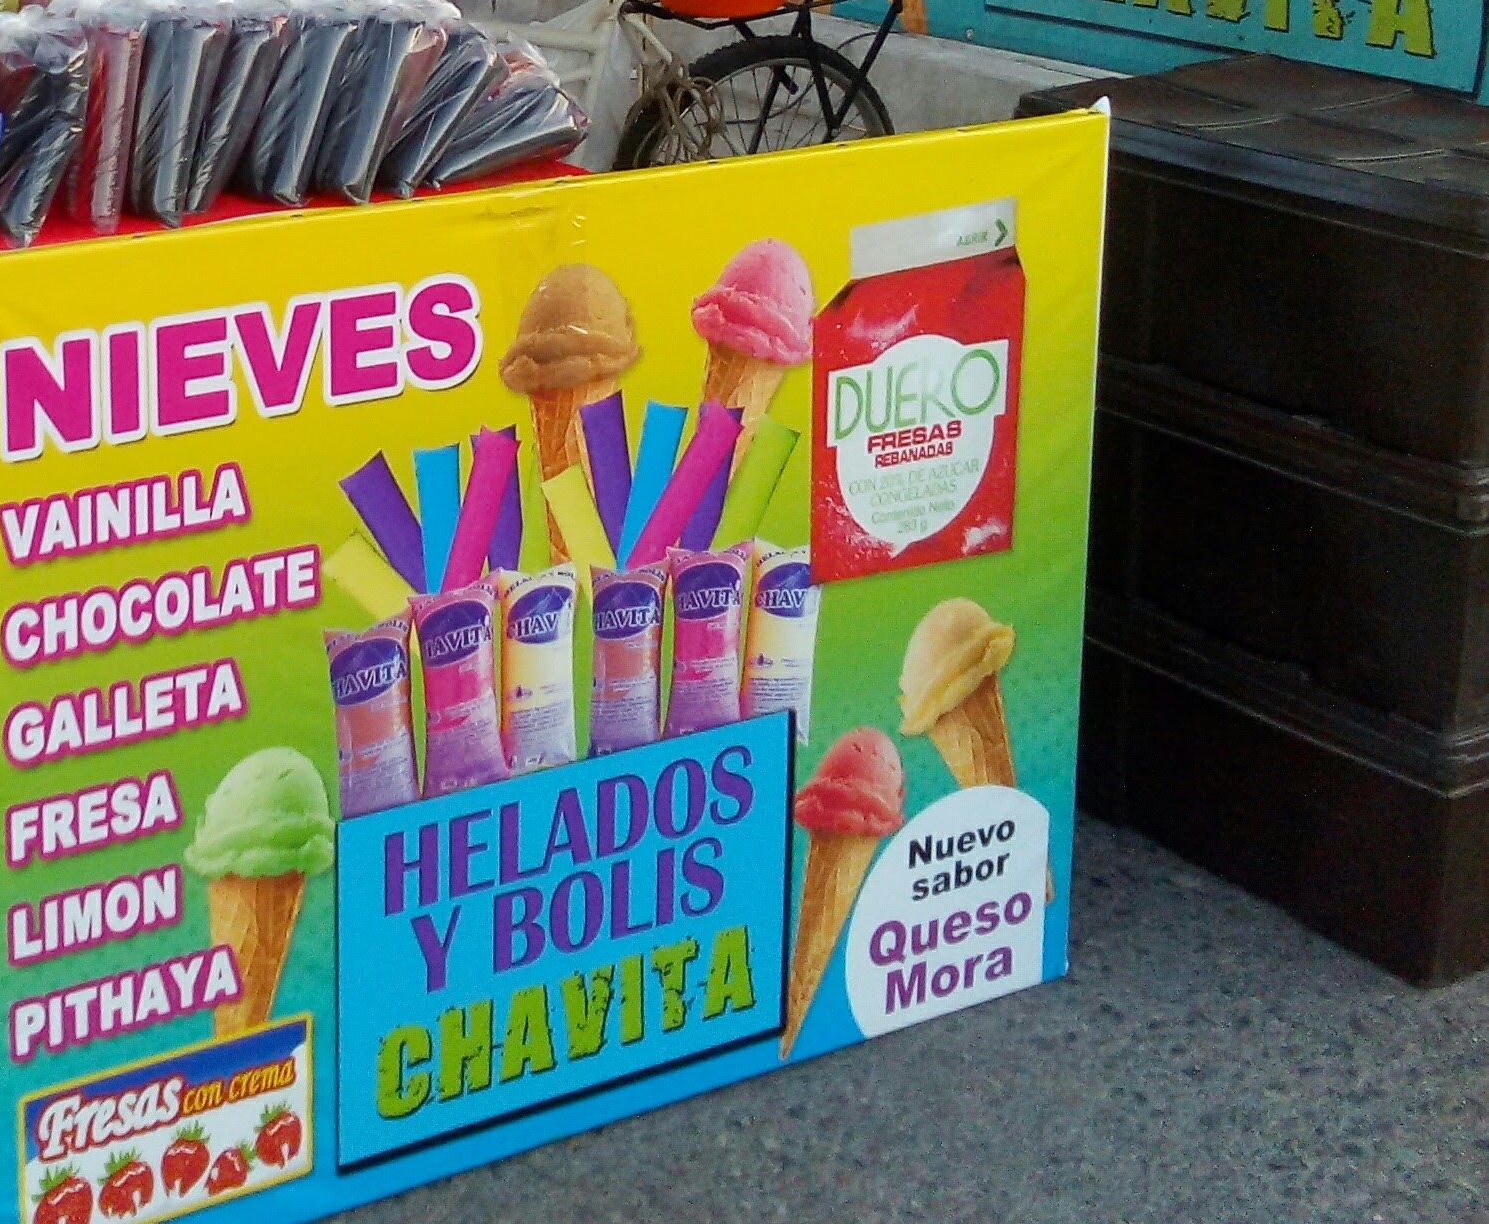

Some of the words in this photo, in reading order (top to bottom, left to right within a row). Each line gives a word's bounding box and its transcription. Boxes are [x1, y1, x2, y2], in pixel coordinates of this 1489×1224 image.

[0, 276, 481, 460] NIEVES
[832, 348, 1002, 442] DUERO
[867, 420, 963, 455] FRESAS
[873, 440, 954, 470] REBANADAS
[0, 465, 247, 562] VAINILLA
[4, 548, 318, 663] CHOCOLATE
[5, 661, 245, 763] GALLETA
[8, 774, 180, 865] FRESA
[383, 744, 755, 918] HELADOS
[908, 818, 1016, 870] Nuevo
[11, 868, 182, 963] LIMON
[410, 904, 462, 994] Y
[491, 836, 724, 974] BOLIS
[911, 851, 1011, 902] sabor
[868, 890, 1033, 968] Queso
[13, 949, 240, 1059] PITHAYA
[375, 924, 758, 1119] CHAVITA
[884, 945, 1013, 1016] Mora
[37, 1076, 184, 1160] Fresas
[183, 1079, 223, 1116] con
[227, 1056, 297, 1104] crema
